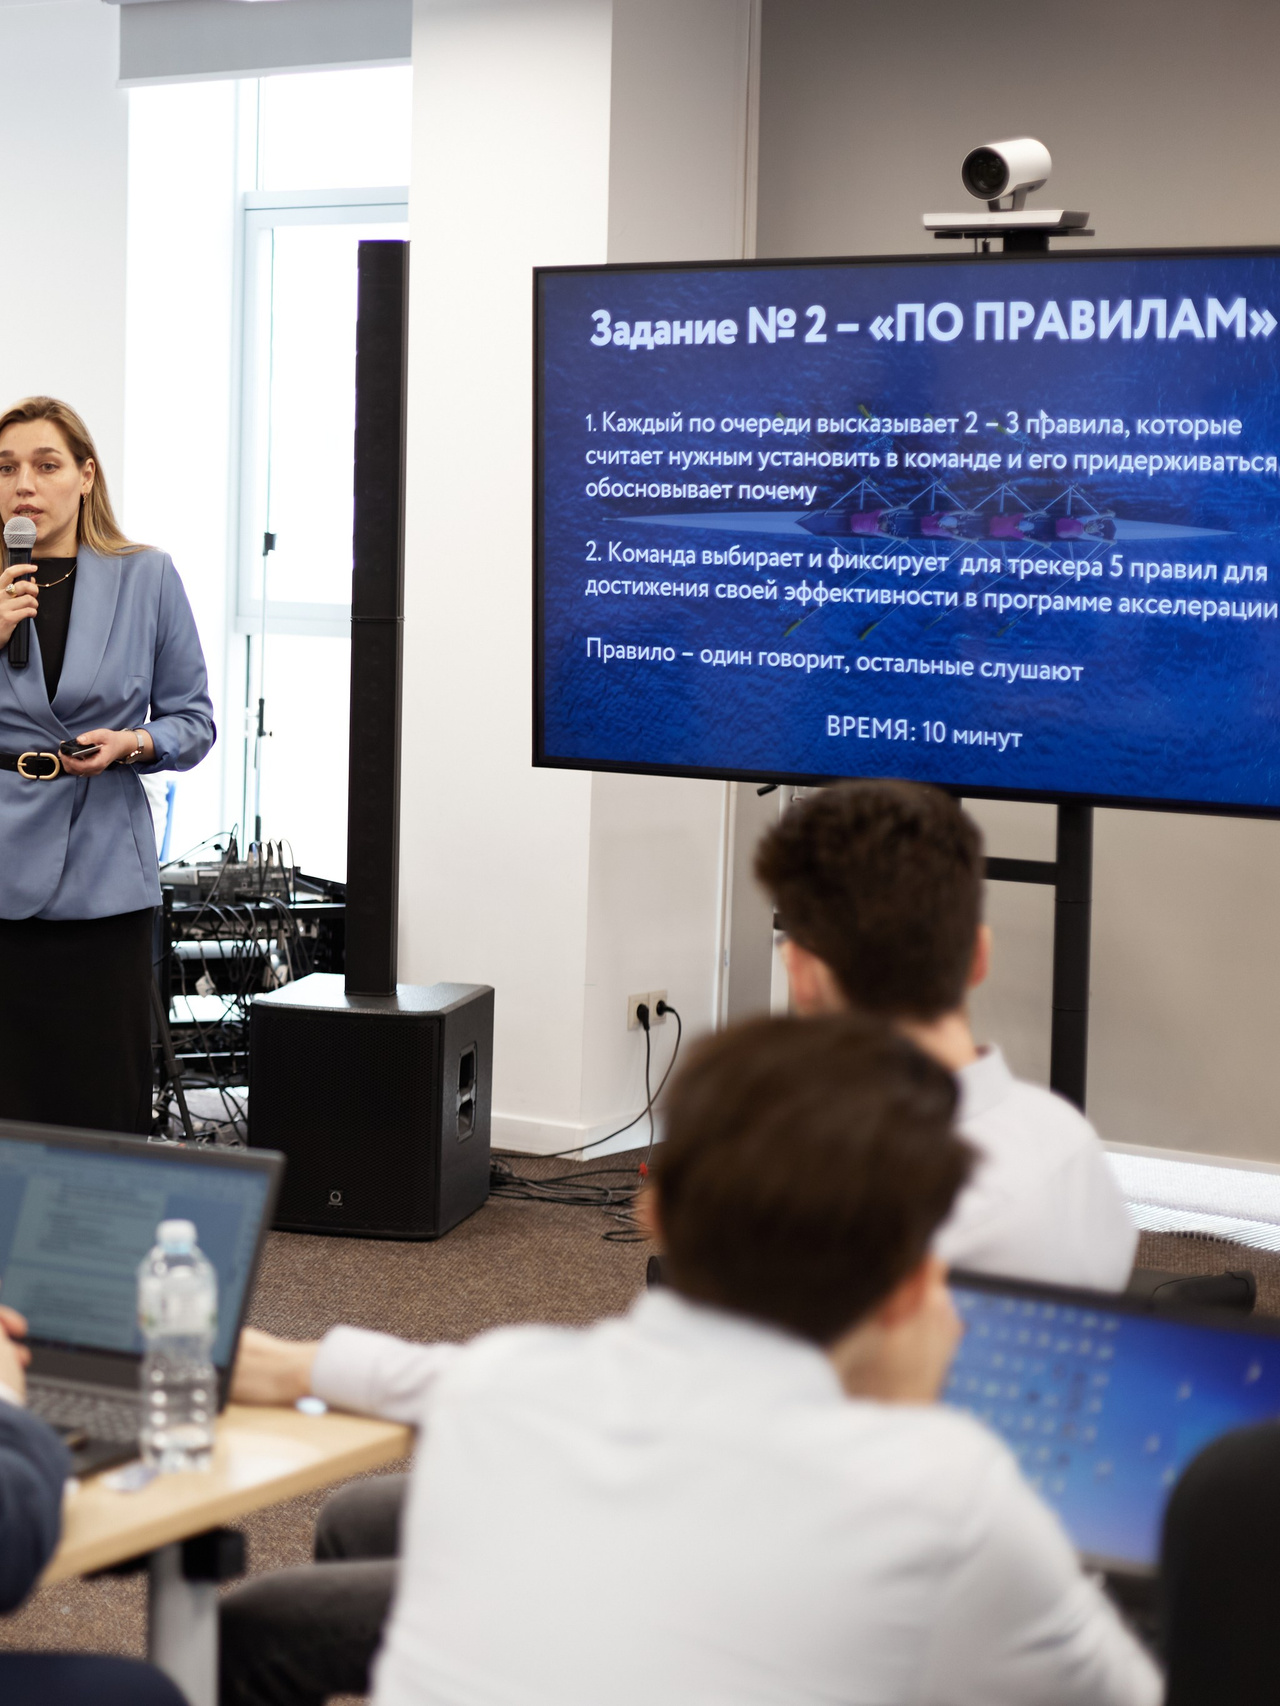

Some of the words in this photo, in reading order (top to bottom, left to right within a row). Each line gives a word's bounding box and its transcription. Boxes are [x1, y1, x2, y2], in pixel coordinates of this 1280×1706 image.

[591, 310, 738, 350] Задание
[748, 306, 796, 343] №
[805, 305, 827, 343] 2
[869, 302, 963, 342] «ПО
[975, 297, 1278, 340] ПРАВИЛАМ»
[585, 414, 597, 432] 1.
[602, 411, 683, 434] Каждый
[690, 417, 715, 432] по
[721, 417, 811, 437] очереди
[817, 417, 959, 434] высказывает
[965, 411, 978, 433] 2
[1006, 411, 1019, 434] 3
[1027, 417, 1131, 439] правила,
[1137, 418, 1243, 440] которые
[585, 449, 663, 465] считает
[669, 450, 752, 470] нужным
[758, 451, 880, 471] установить
[887, 452, 898, 467] в
[905, 452, 1002, 471] команде
[1008, 453, 1022, 468] и
[1029, 453, 1067, 469] его
[585, 476, 733, 498] обосновывает
[739, 484, 817, 505] почему
[585, 540, 601, 562] 2.
[608, 541, 696, 567] Команда
[702, 545, 803, 571] выбирает
[809, 551, 821, 568] и
[828, 547, 949, 576] фиксирует
[960, 557, 1001, 575] для
[1008, 558, 1103, 581] трекера
[1110, 554, 1123, 577] 5
[1130, 561, 1218, 583] правил
[1223, 564, 1268, 583] для
[585, 578, 709, 597] достижения
[715, 579, 778, 600] своей
[784, 580, 958, 607] эффективности
[965, 592, 977, 607] в
[984, 592, 1112, 615] программе
[1118, 596, 1279, 621] акселерации
[586, 637, 675, 663] Правило
[700, 648, 752, 666] один
[758, 650, 851, 674] говорит,
[856, 655, 974, 676] остальные
[980, 661, 1084, 683] слушают
[827, 715, 916, 741] ВРЕМЯ:
[922, 720, 946, 742] 10
[953, 729, 1023, 752] минут
